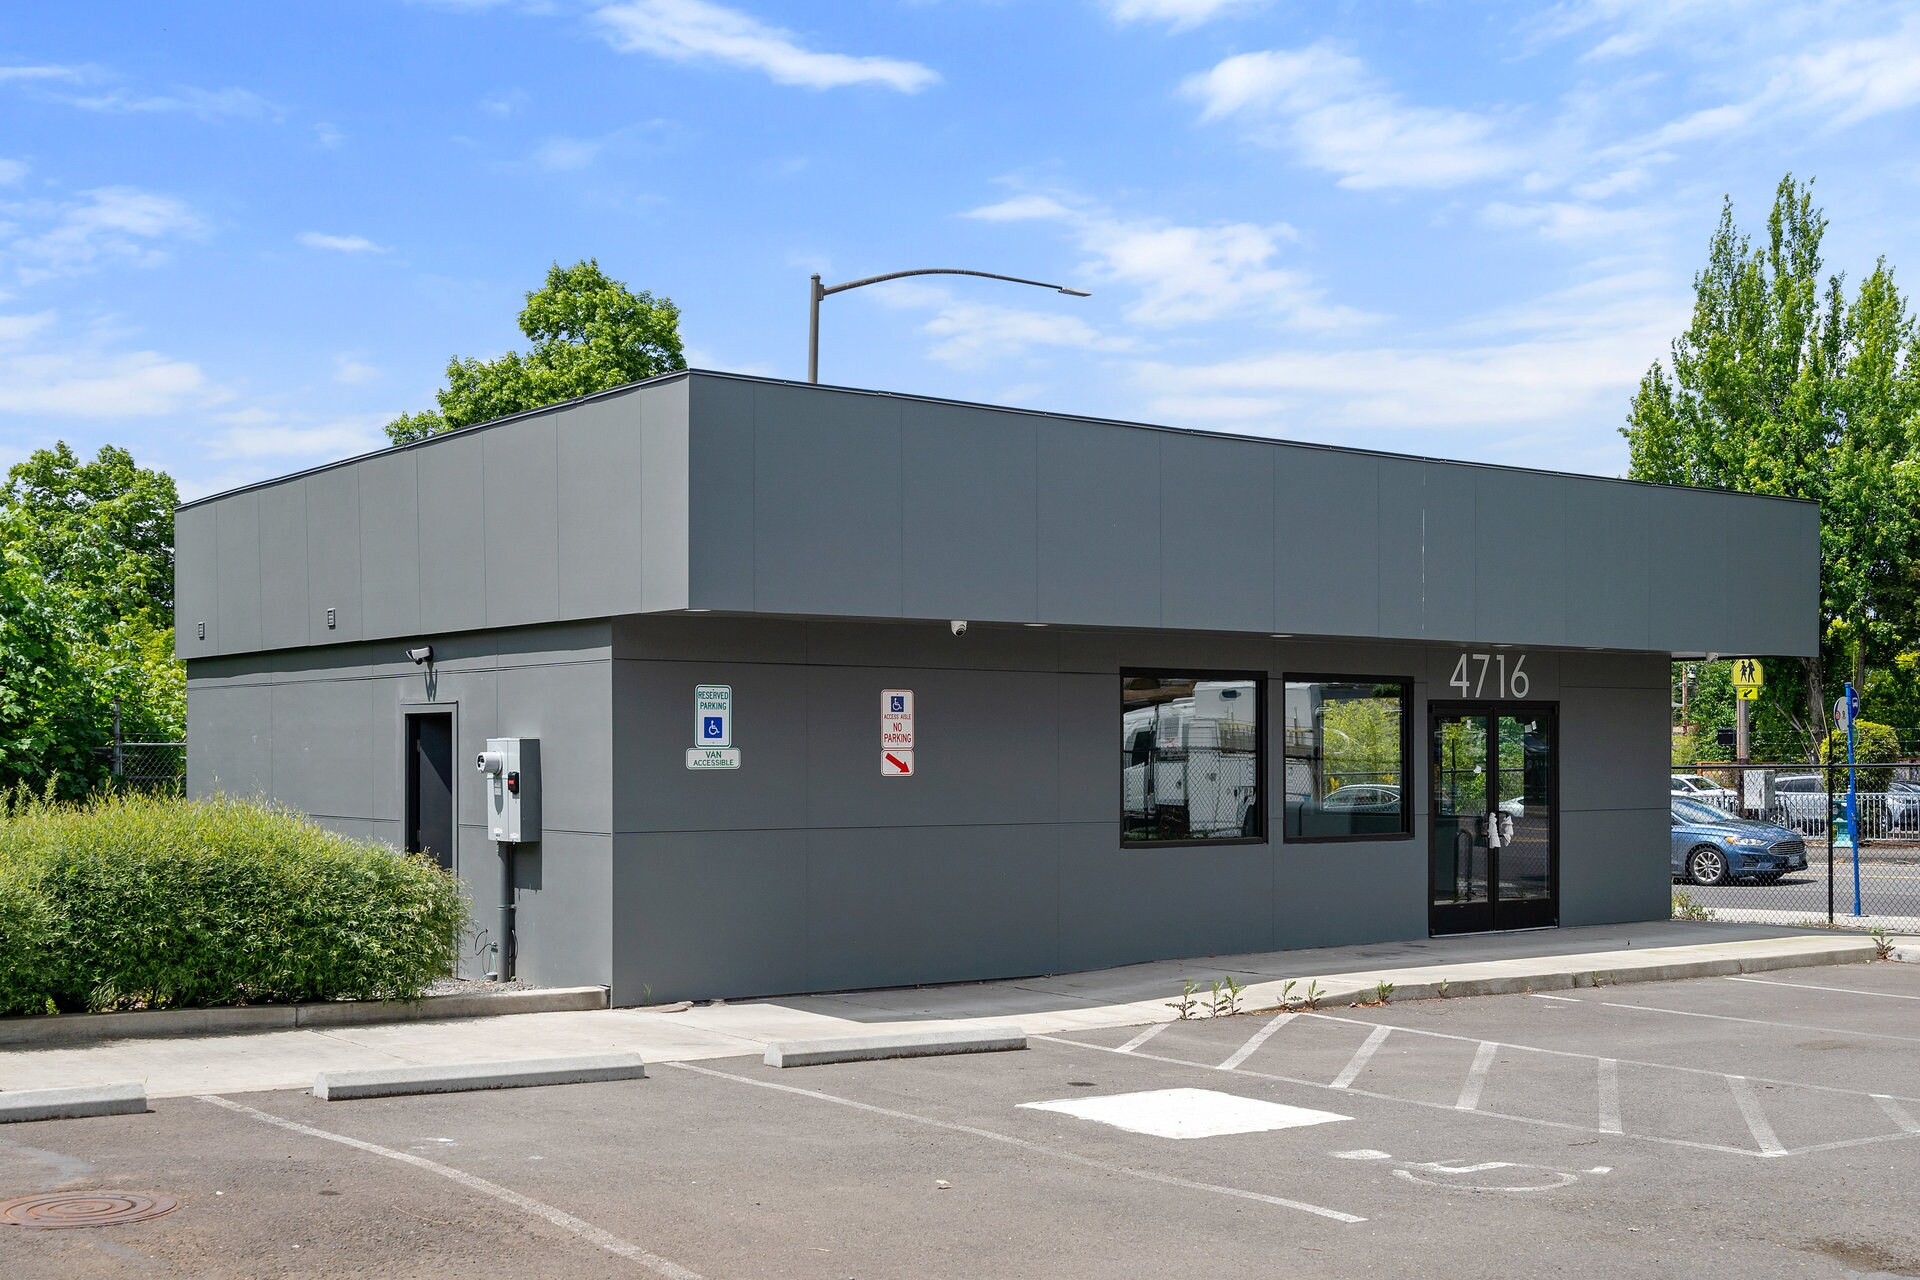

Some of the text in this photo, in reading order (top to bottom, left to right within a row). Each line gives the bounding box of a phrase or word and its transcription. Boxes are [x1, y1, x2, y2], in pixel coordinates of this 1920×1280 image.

[1449, 653, 1530, 699] 4716
[698, 691, 729, 700] RESERVED
[699, 702, 727, 710] PARKING
[892, 722, 903, 732] NO
[883, 733, 912, 743] PARKING
[705, 750, 722, 759] VAN
[693, 759, 735, 767] ACCESSIBLE
